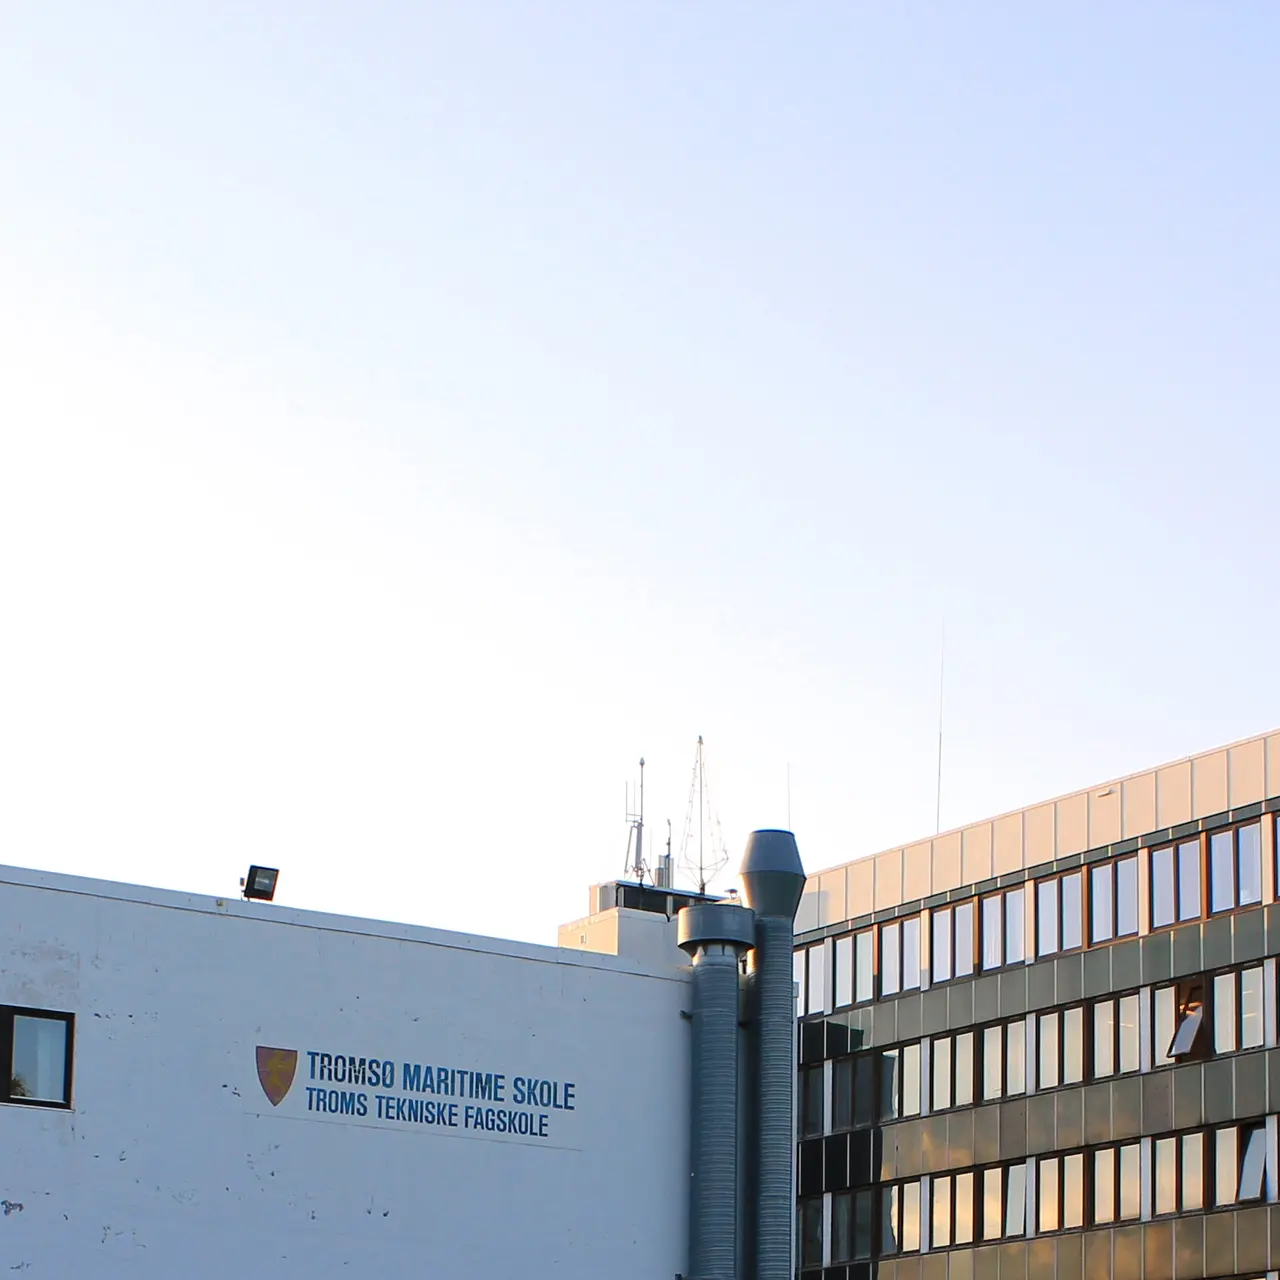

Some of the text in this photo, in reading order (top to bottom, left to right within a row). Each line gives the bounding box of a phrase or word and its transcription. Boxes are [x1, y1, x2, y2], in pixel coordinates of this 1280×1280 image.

[306, 1050, 576, 1111] TROMSØ MARITIME SKOLE
[305, 1086, 549, 1138] TROMS TEKNISKE FAGSKOLE
